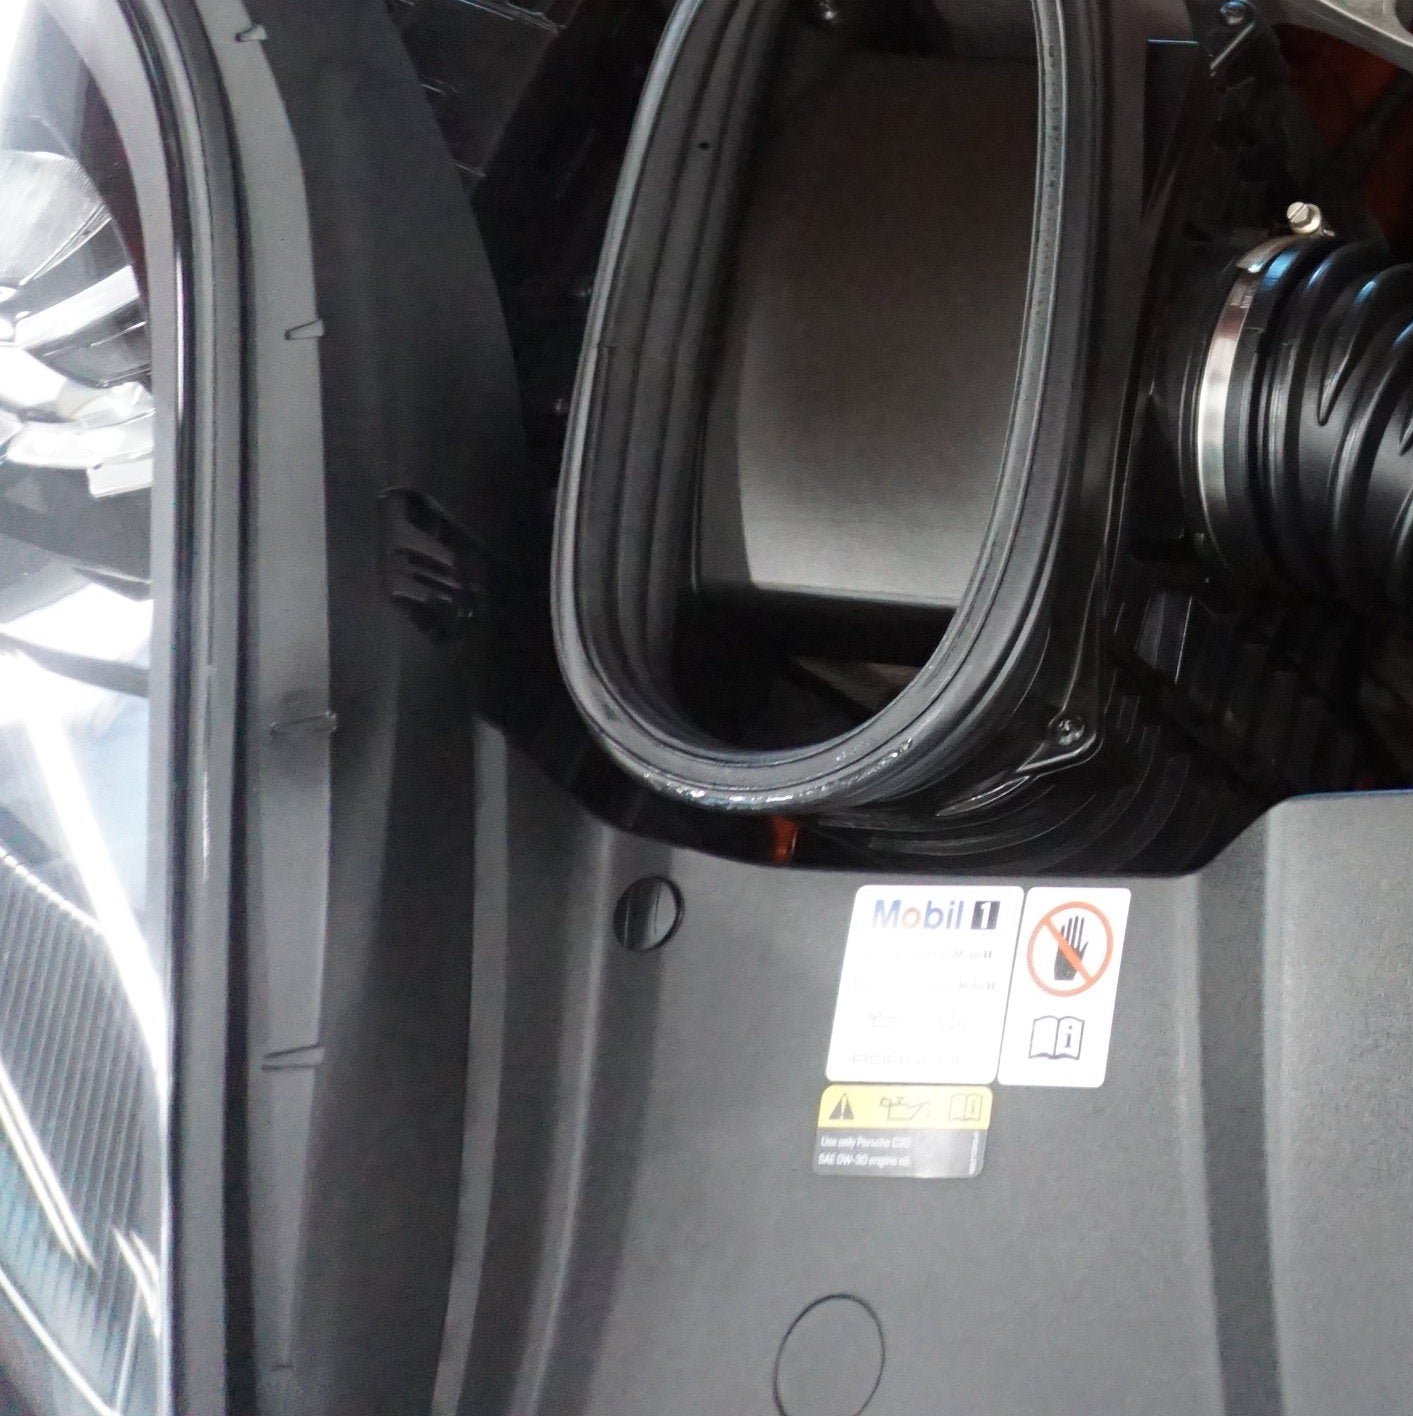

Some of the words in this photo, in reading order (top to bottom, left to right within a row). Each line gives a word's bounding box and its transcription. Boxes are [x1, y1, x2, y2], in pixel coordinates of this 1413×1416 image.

[872, 899, 964, 930] Mobil
[821, 1136, 835, 1147] Use
[838, 1136, 856, 1150] only
[857, 1136, 891, 1148] Porsche
[818, 1151, 835, 1165] SAE
[869, 1155, 897, 1168] engine
